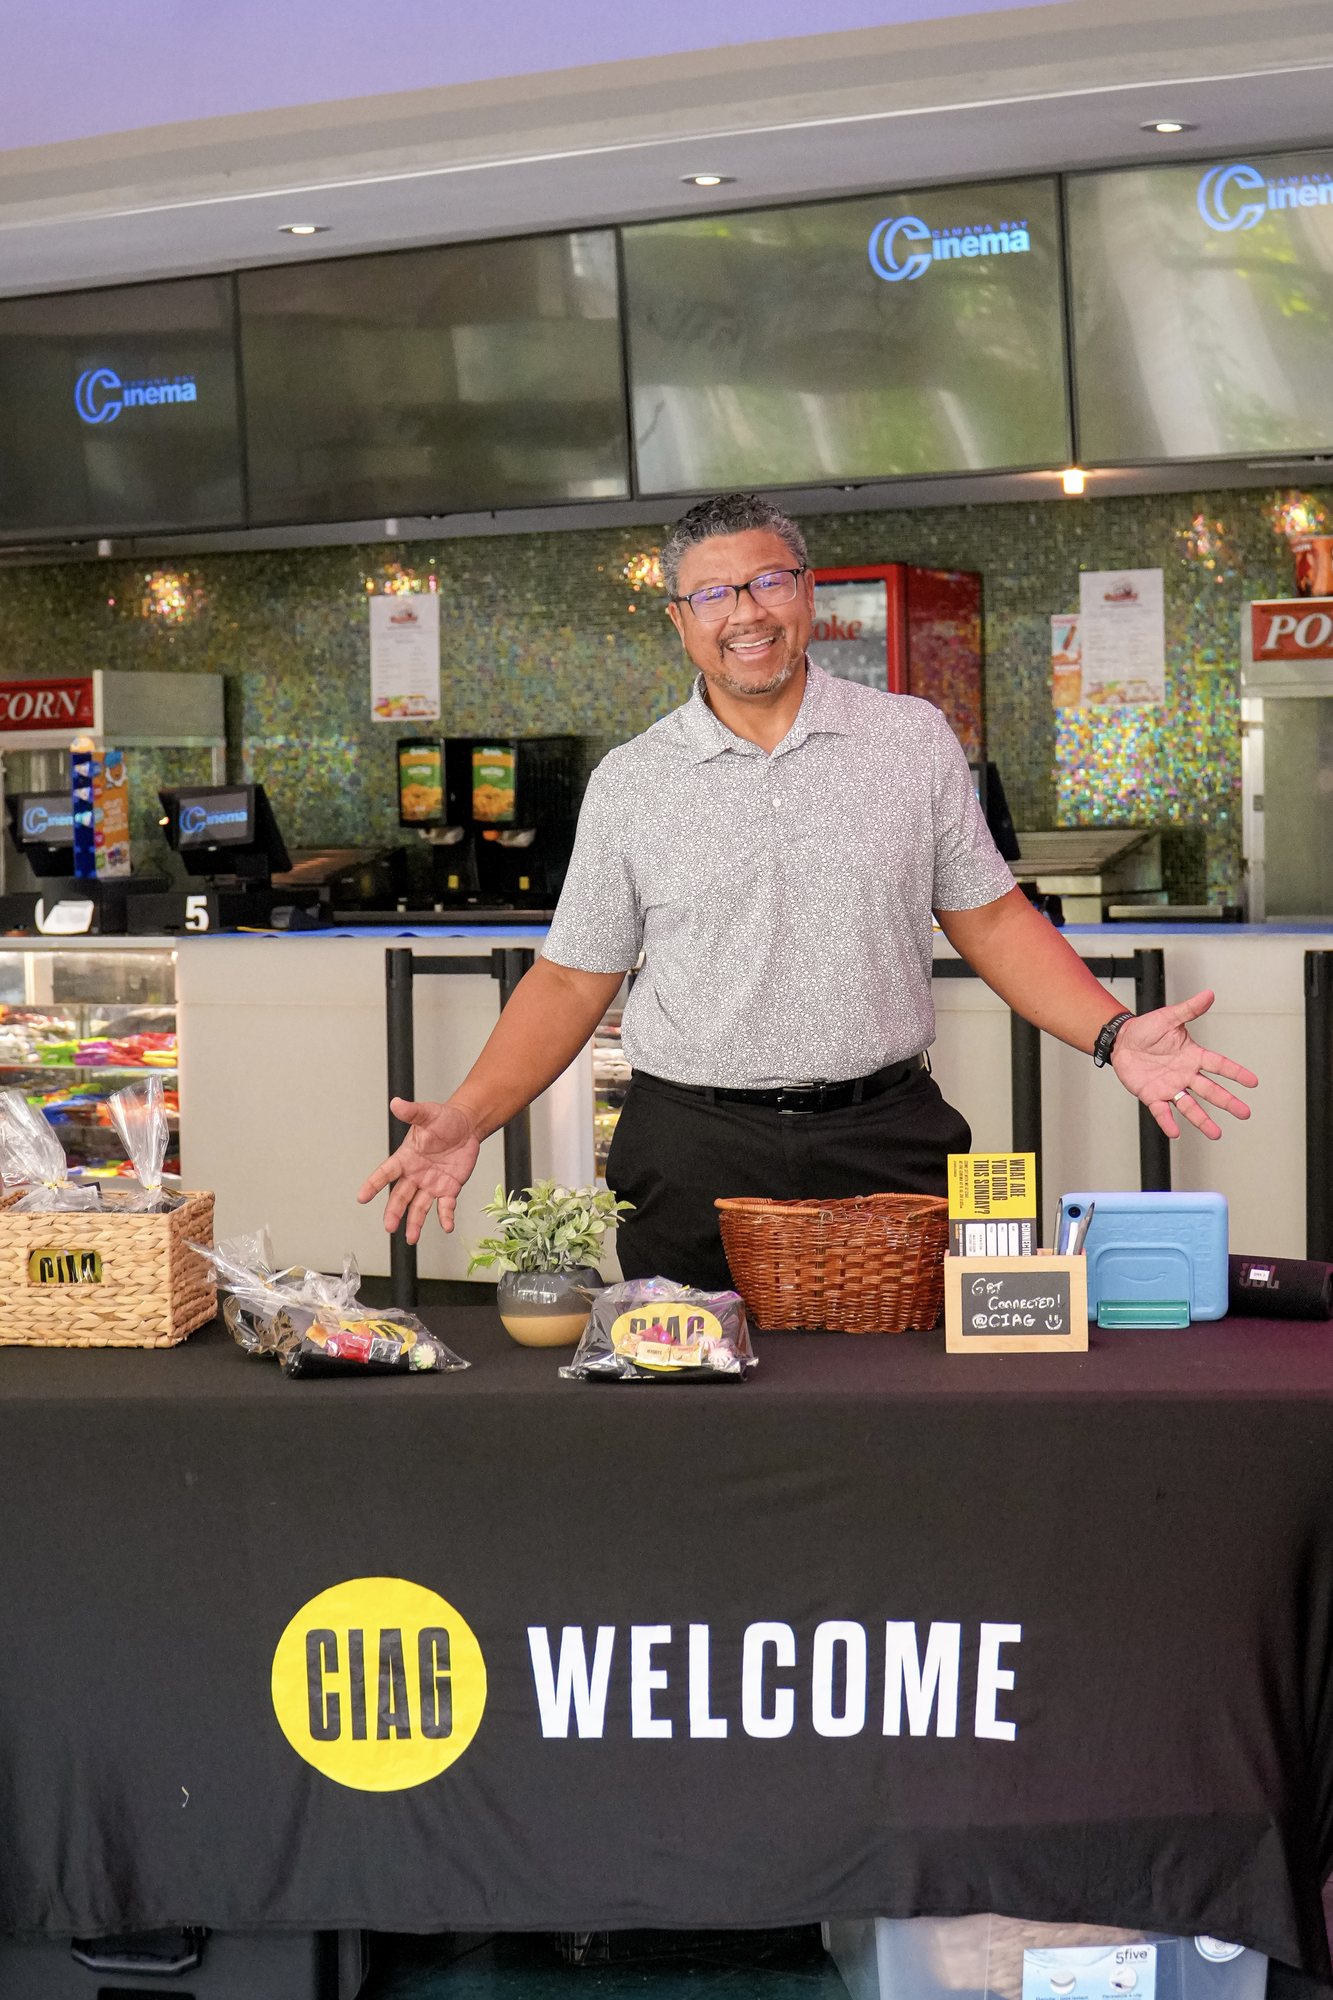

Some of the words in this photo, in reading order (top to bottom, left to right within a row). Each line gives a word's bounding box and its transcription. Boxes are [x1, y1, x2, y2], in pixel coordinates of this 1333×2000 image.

[868, 215, 1031, 282] Cinema
[74, 367, 198, 424] Cinema
[811, 613, 863, 641] oke
[1260, 612, 1333, 650] PO
[185, 895, 210, 932] 5
[973, 1160, 989, 1177] THIS
[991, 1159, 1008, 1175] YOU
[1009, 1159, 1025, 1180] WHAT
[973, 1179, 990, 1215] SUNDAY?
[991, 1177, 1008, 1201] DOING
[1009, 1183, 1026, 1198] ARE
[972, 1313, 1036, 1329] @CIAG
[305, 1626, 453, 1742] CIAG
[526, 1620, 1022, 1742] WELCOME
